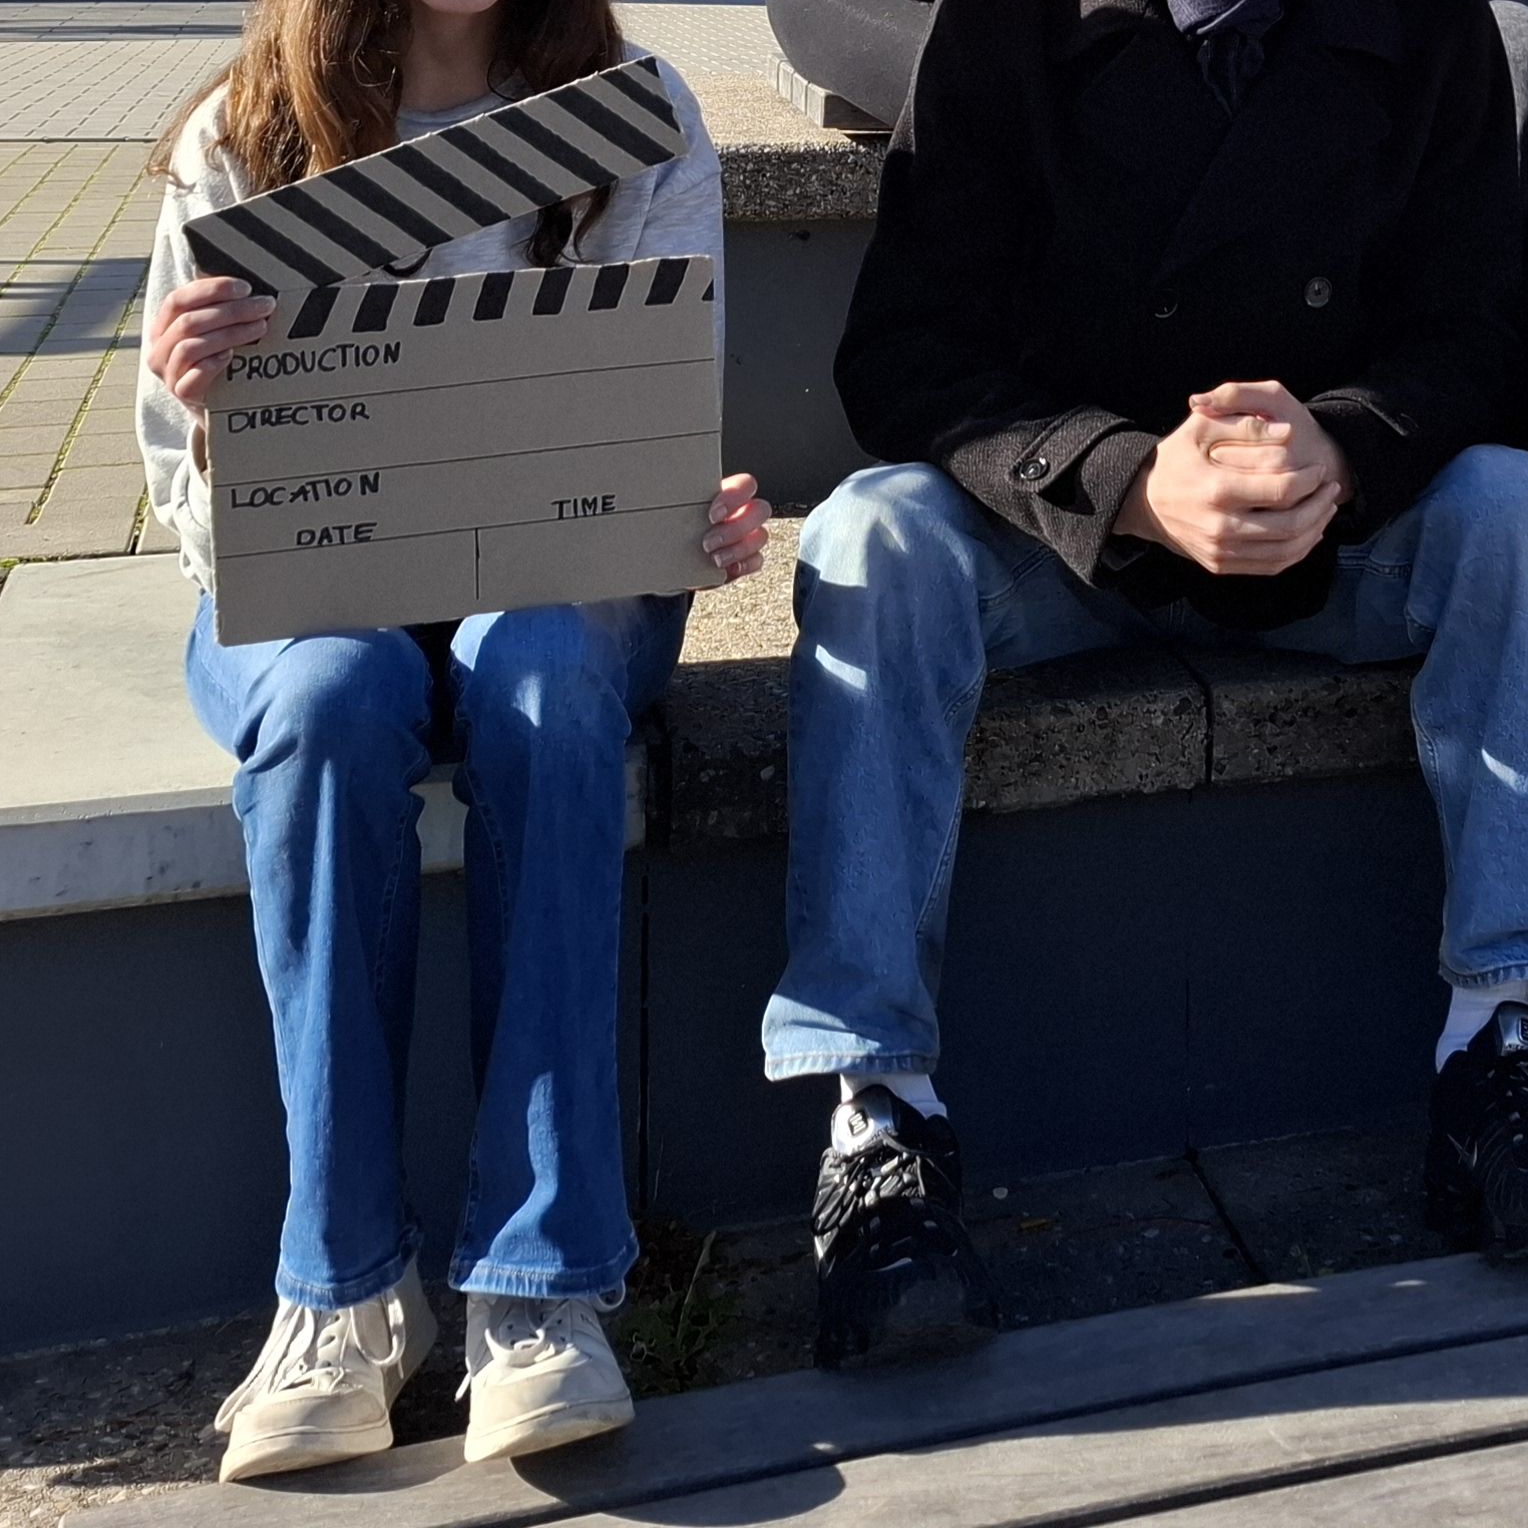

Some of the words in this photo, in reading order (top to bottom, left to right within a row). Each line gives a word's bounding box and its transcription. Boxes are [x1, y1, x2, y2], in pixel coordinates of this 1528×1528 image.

[225, 340, 402, 382] PRODUCTION
[227, 402, 370, 434] DIRECTOR
[231, 472, 382, 510] LOCATION
[551, 494, 617, 521] TIME
[296, 522, 378, 547] DATE
